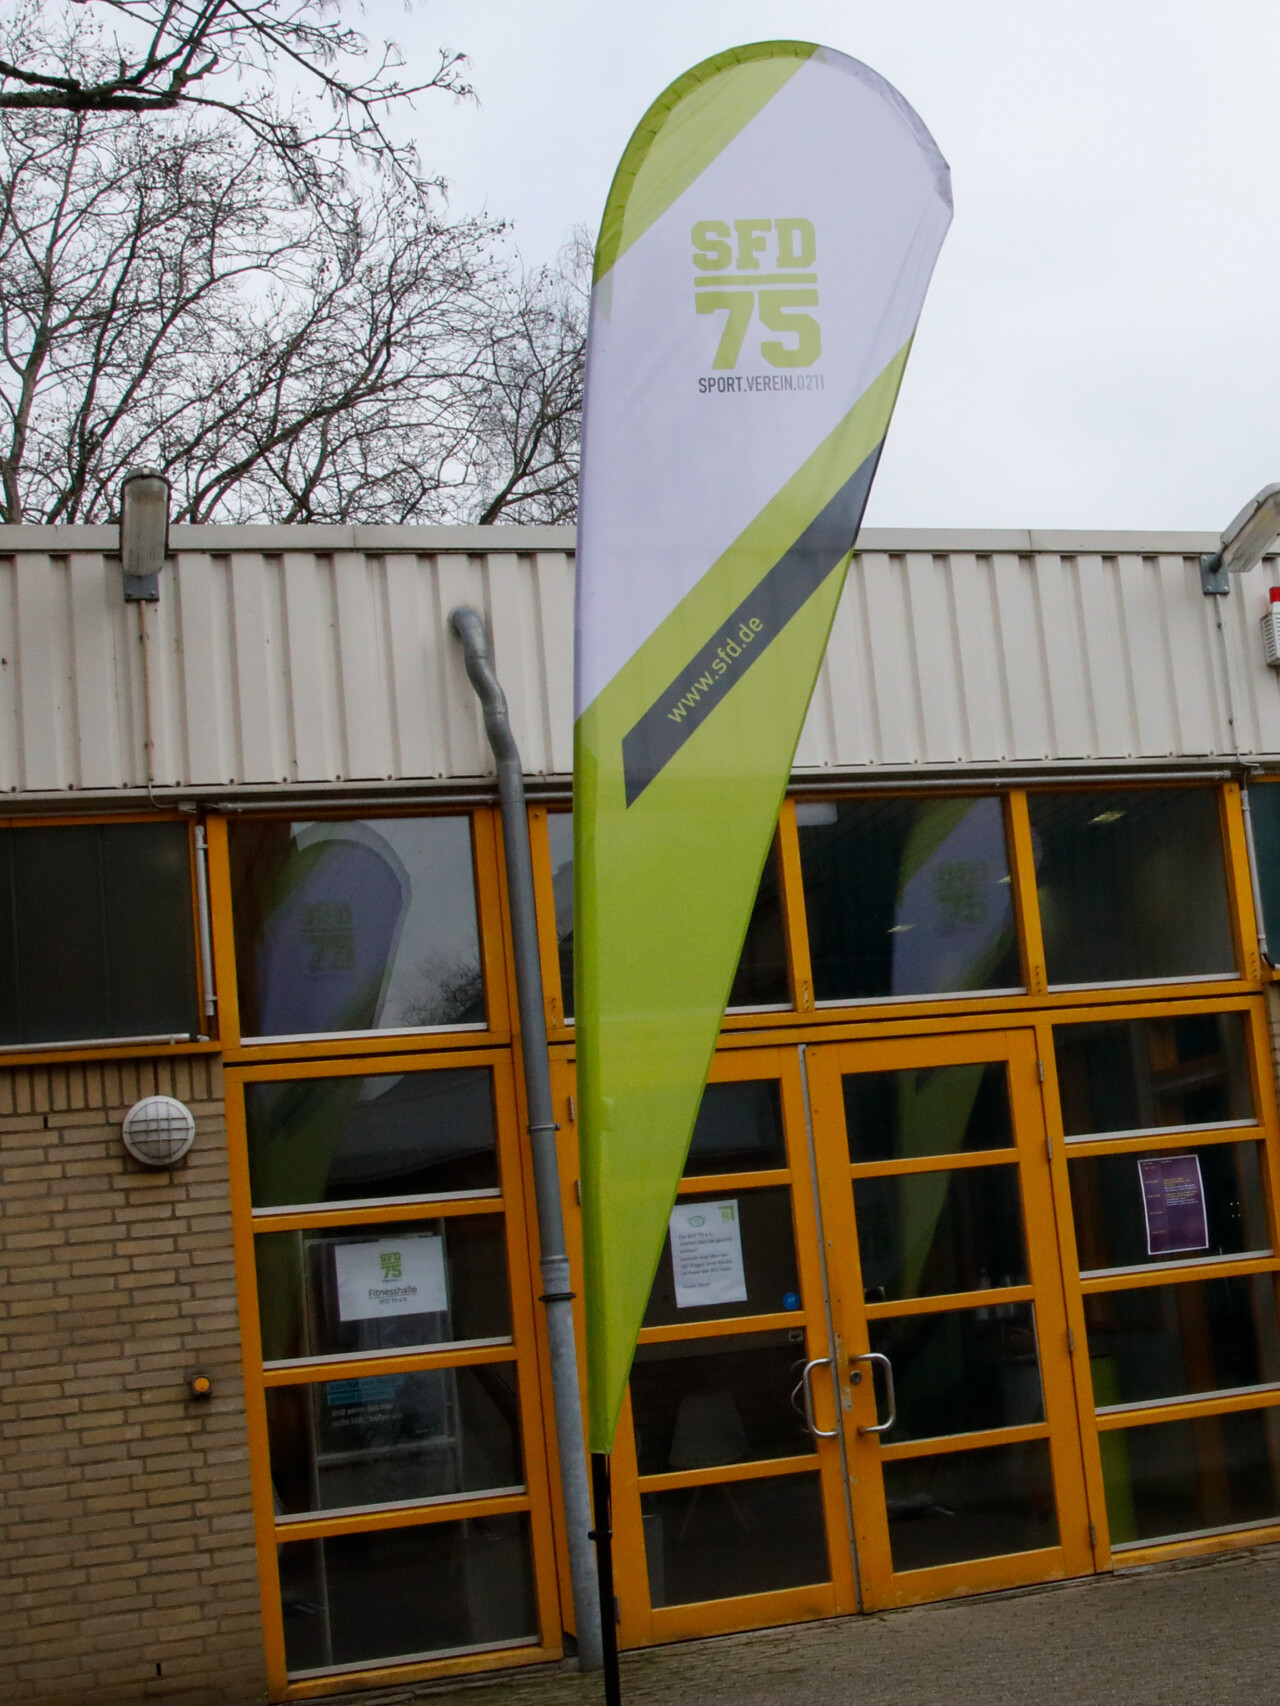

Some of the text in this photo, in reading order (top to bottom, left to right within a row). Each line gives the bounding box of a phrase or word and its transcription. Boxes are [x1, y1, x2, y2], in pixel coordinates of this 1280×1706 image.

[691, 218, 817, 271] SFD
[695, 289, 822, 370] 75
[698, 374, 825, 393] SPORT.VEREIN.0211
[667, 617, 764, 723] www.sfd.de
[380, 1252, 402, 1263] SFD
[380, 1263, 403, 1279] 75
[368, 1285, 418, 1297] Fitnesshalle
